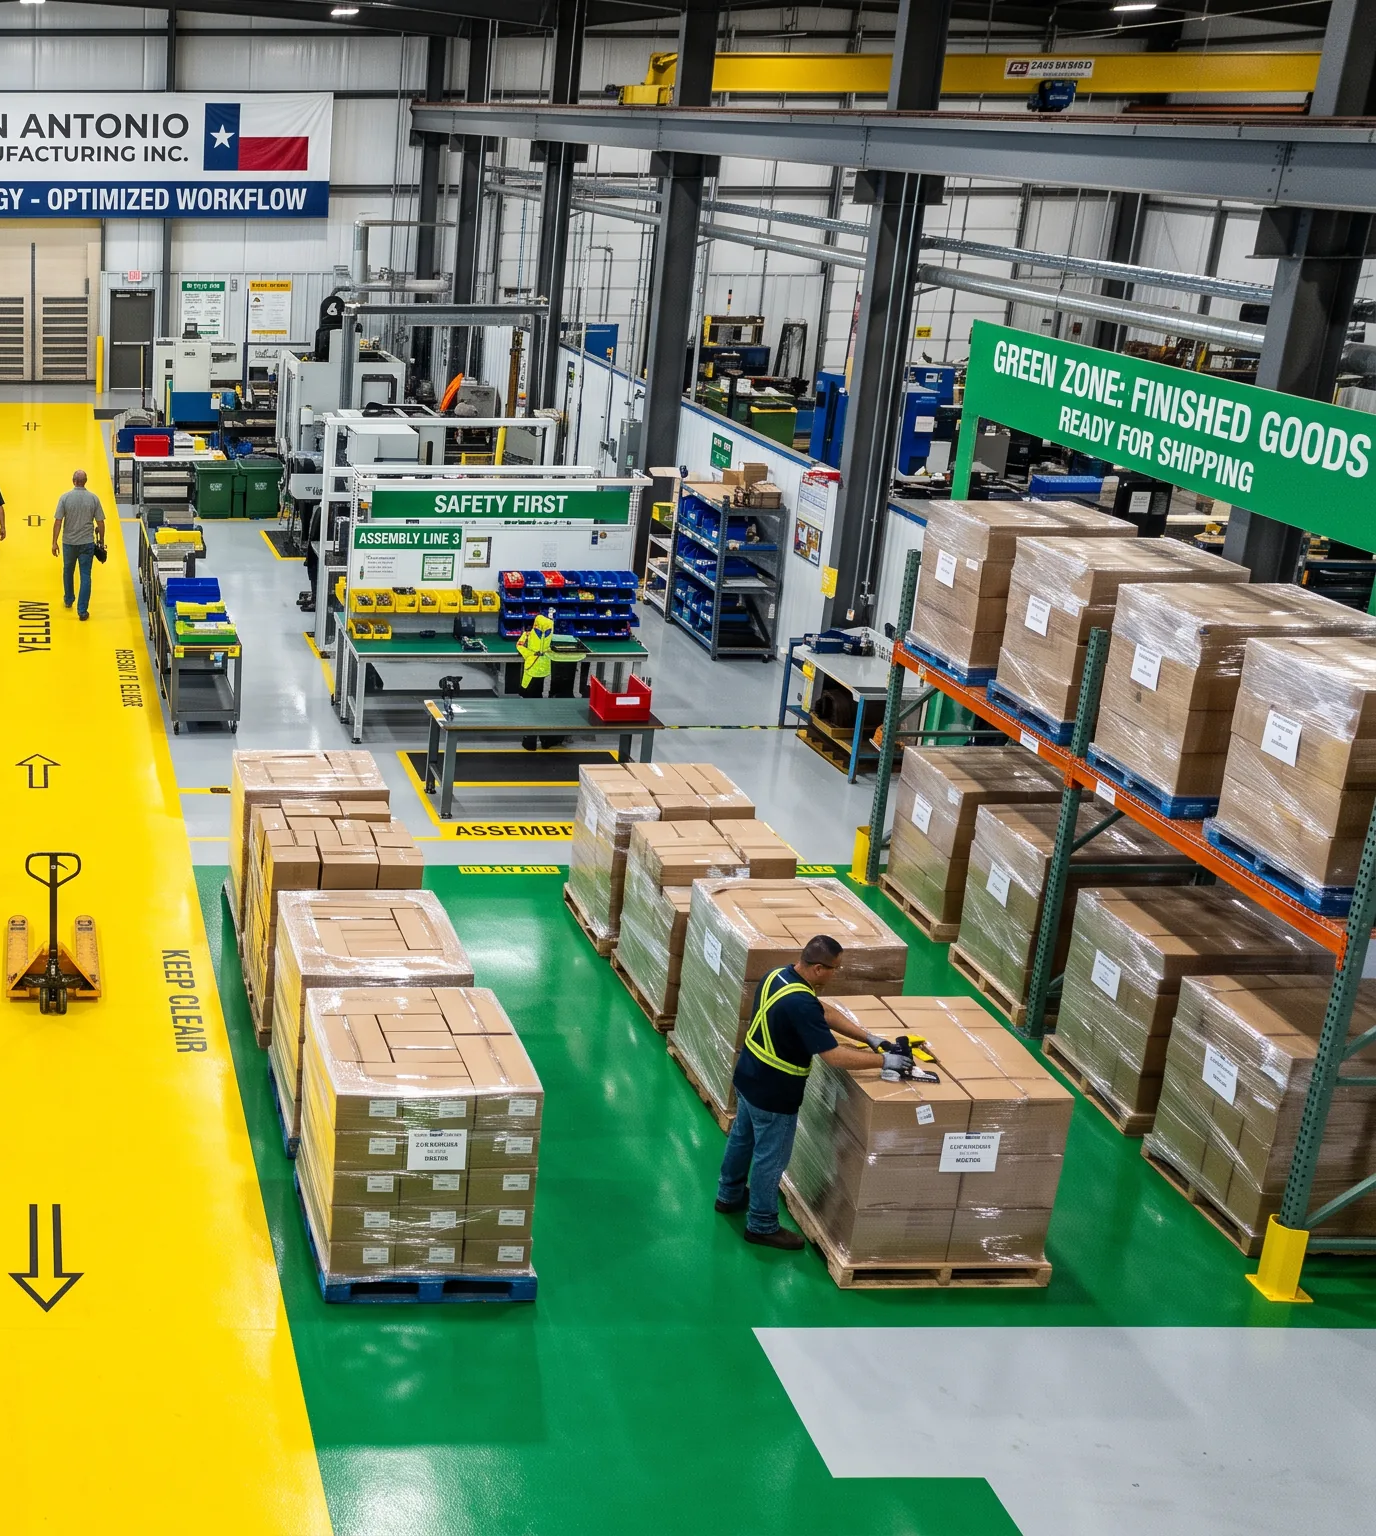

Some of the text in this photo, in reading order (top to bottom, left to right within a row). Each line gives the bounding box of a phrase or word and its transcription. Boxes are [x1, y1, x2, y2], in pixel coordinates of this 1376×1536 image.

[19, 113, 189, 139] ANTONIO
[143, 145, 189, 162] INC.
[47, 188, 170, 211] OPTIMIZED
[175, 188, 308, 211] WORKFLOW
[994, 341, 1372, 477] GREEN ZONE: FINISHED GOODS
[1059, 407, 1255, 494] READY FOR SHIPPING
[434, 494, 569, 514] SAFETY FIRST
[359, 532, 460, 545] ASSEMBLY LINE 3
[17, 600, 51, 654] YELLOW
[161, 949, 196, 989] KEEP
